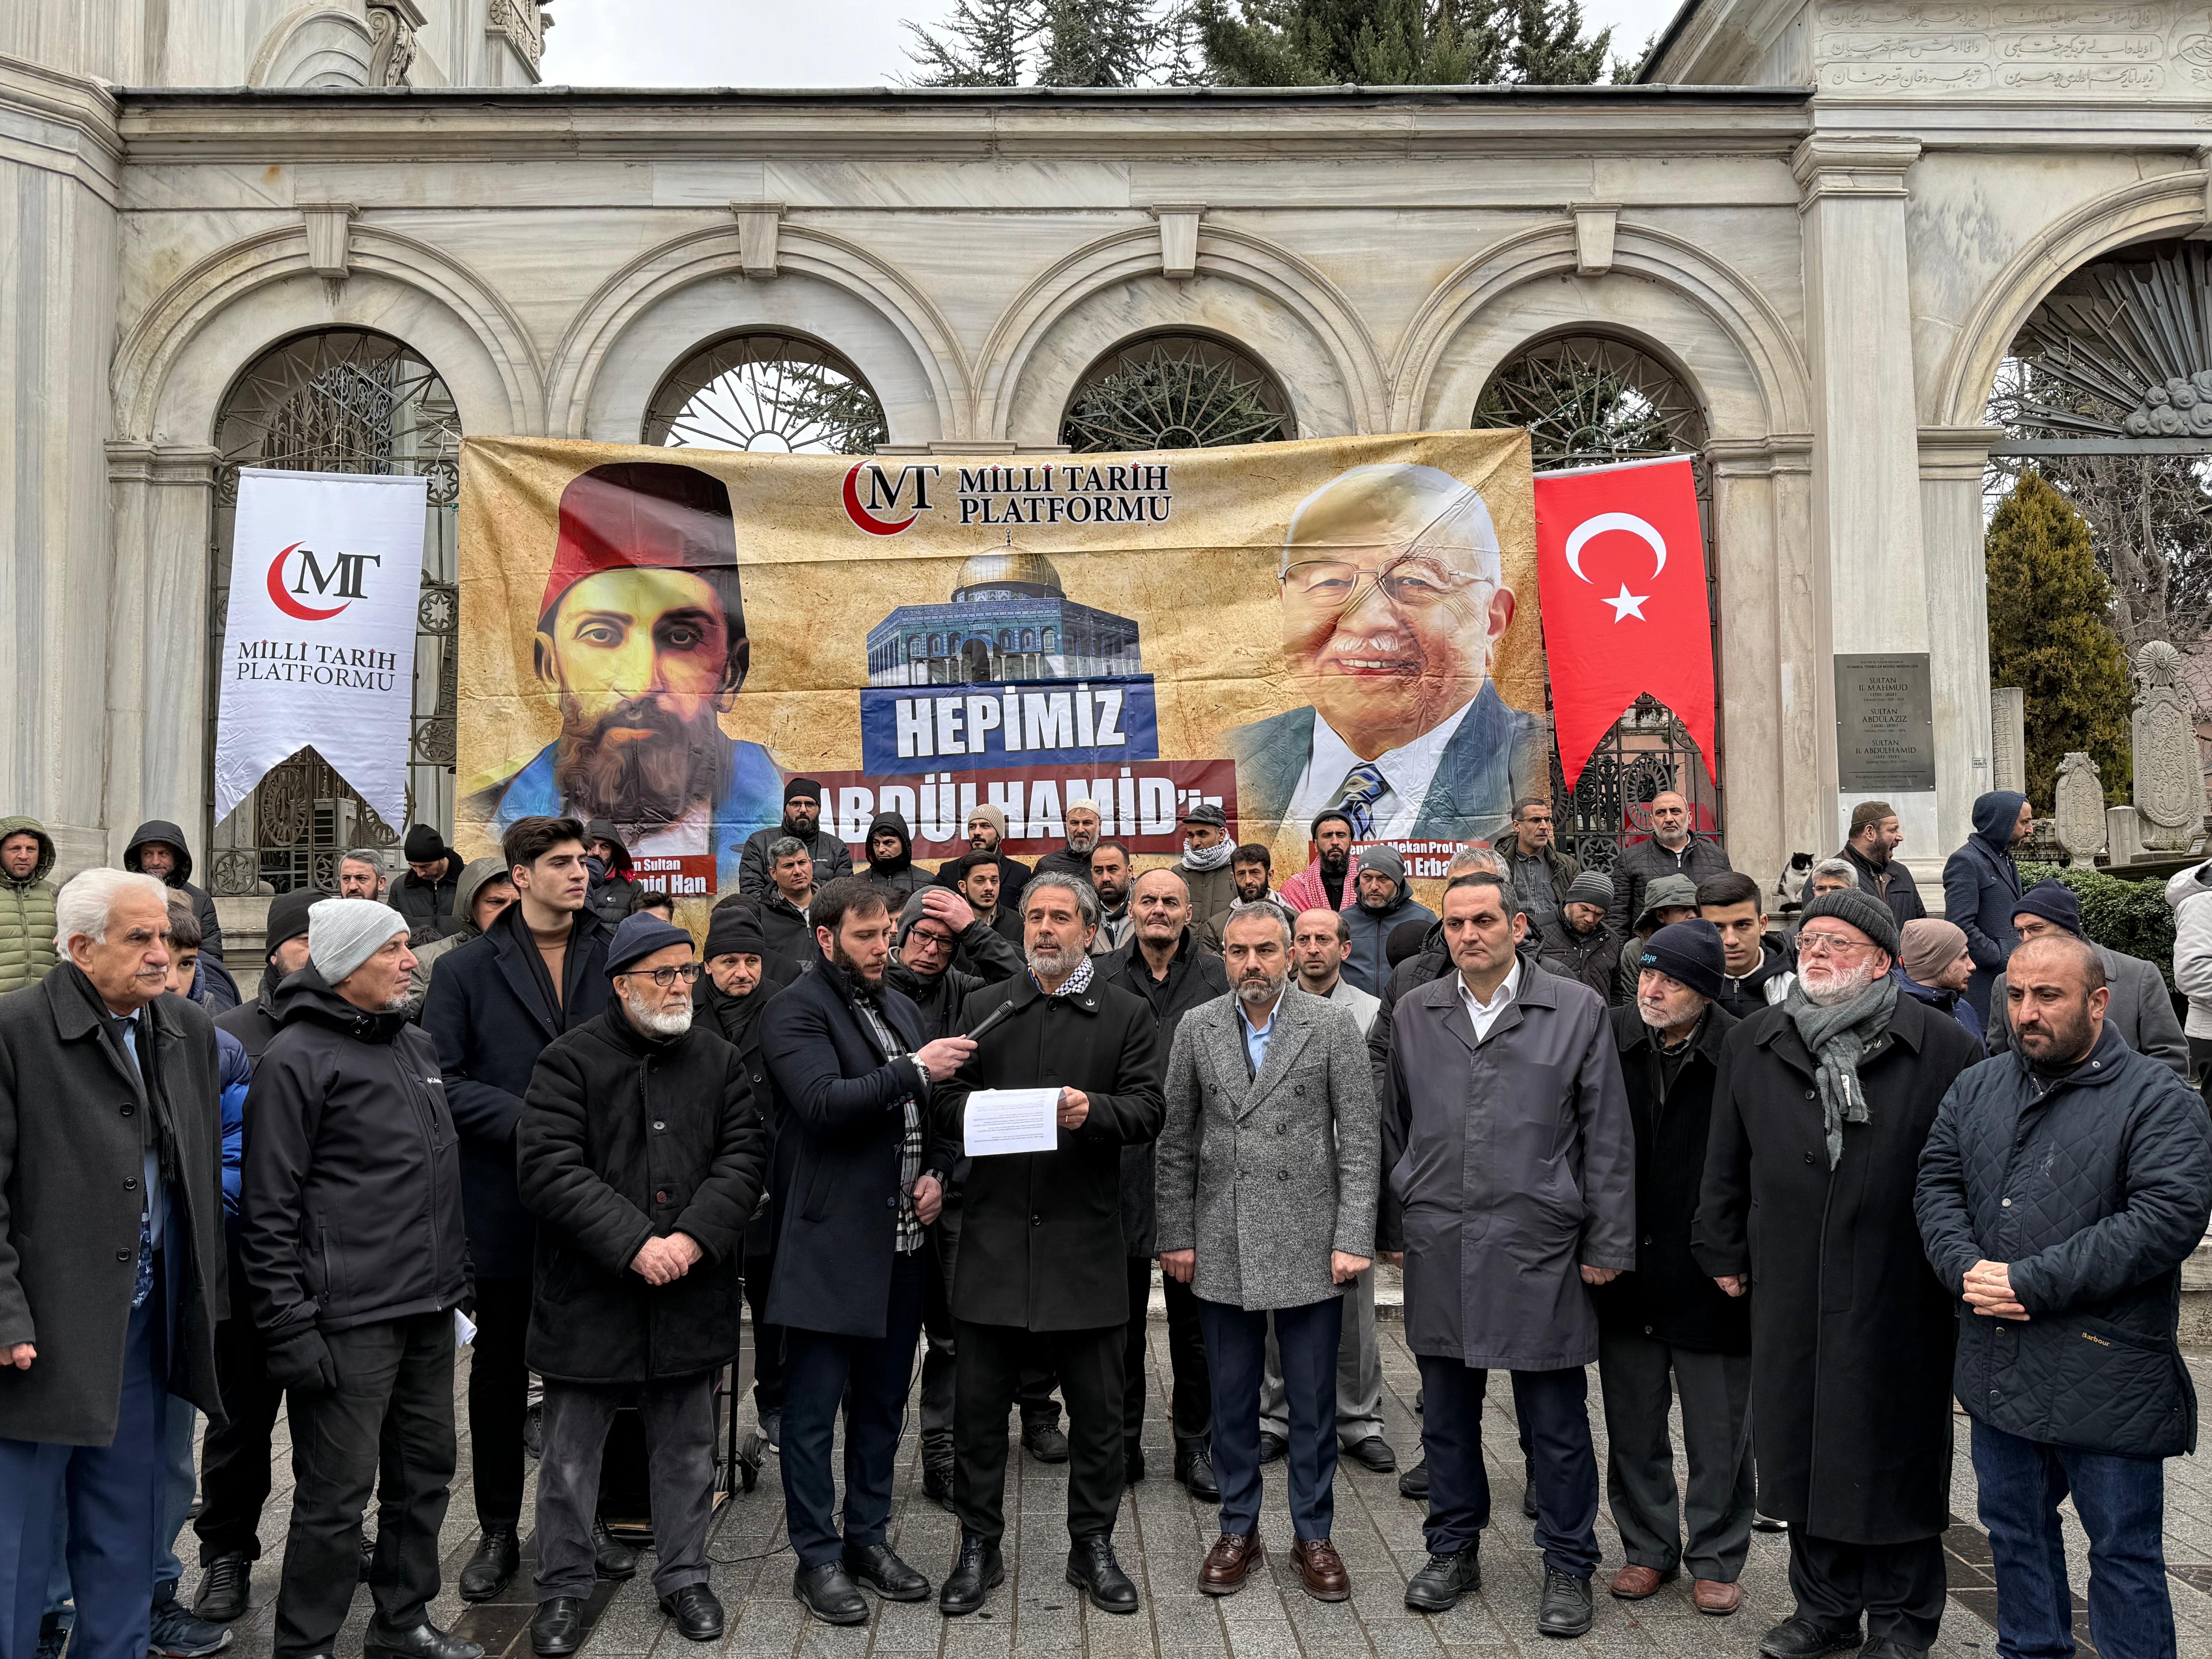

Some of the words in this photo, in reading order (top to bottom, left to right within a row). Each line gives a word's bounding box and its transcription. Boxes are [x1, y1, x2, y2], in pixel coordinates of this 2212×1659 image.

[866, 465, 939, 510] MT
[959, 463, 1054, 492] MİLLİ
[1063, 461, 1169, 491] TARİH
[960, 495, 1173, 524] PLATFORMU
[291, 550, 380, 599] MT
[238, 639, 308, 661] MİLLİ
[315, 645, 397, 670] TARİH
[236, 662, 395, 691] PLATFORMU
[896, 683, 1125, 758] HEPİMİZ
[1387, 841, 1427, 854] Mekan
[644, 858, 680, 871] Sultan
[1415, 857, 1450, 877] Erba
[671, 874, 706, 894] Han
[2082, 1332, 2110, 1347] Barbour
